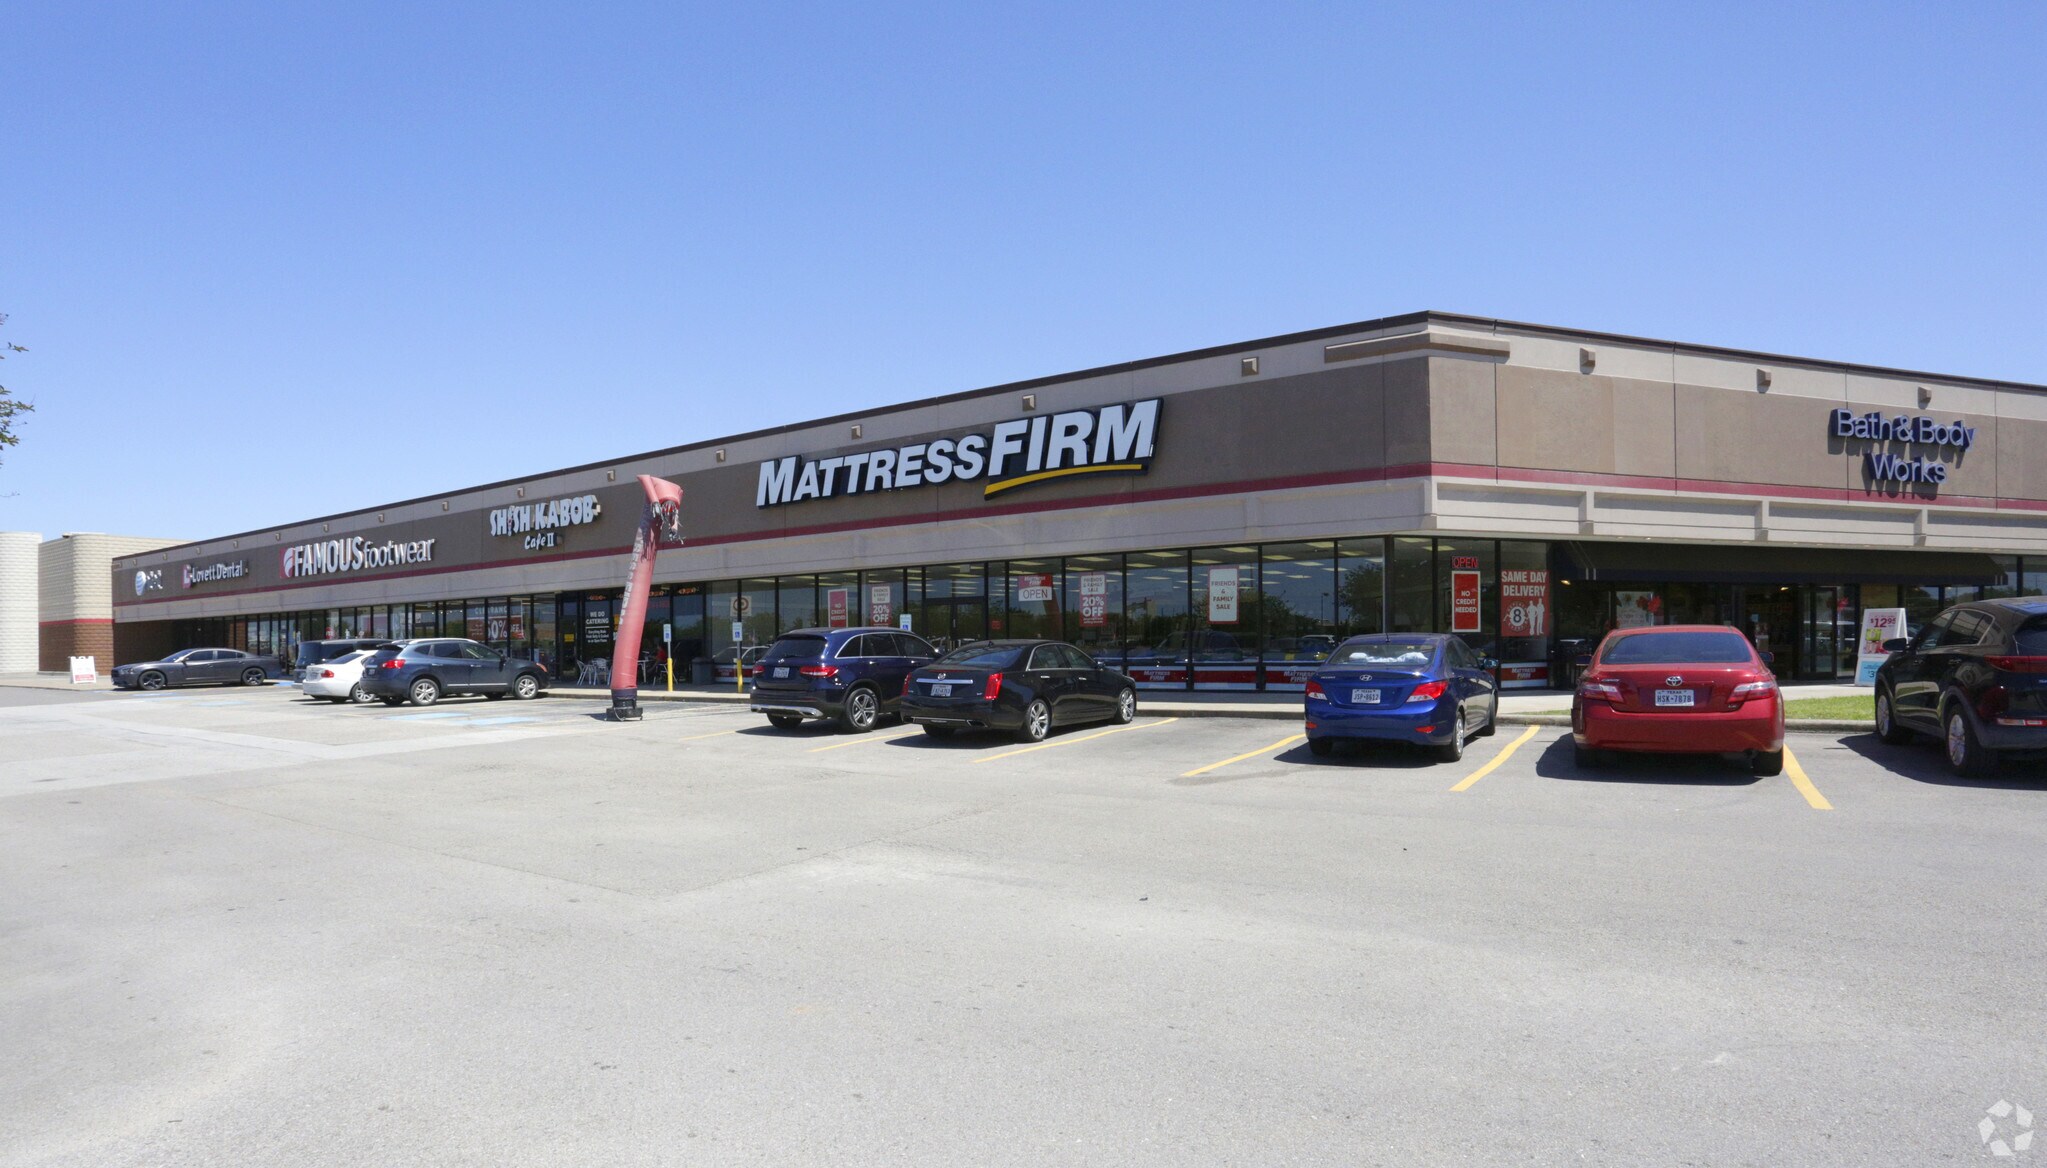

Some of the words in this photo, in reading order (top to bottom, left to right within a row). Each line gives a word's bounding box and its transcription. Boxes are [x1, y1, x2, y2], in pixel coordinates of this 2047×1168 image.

[1831, 408, 1892, 441] Bath
[1893, 414, 1915, 443] &
[1915, 415, 1976, 453] Body
[756, 434, 986, 507] MATTRESS
[985, 398, 1160, 478] FIRM
[1869, 451, 1948, 484] Works
[535, 495, 600, 530] KABOB
[524, 533, 547, 550] Cafe
[294, 537, 364, 577] FAMOUS
[363, 538, 435, 569] footwear
[1453, 557, 1478, 568] OPEN
[191, 565, 217, 583] Lovett
[216, 560, 243, 579] Dental
[1501, 571, 1527, 583] SAME
[1530, 571, 1547, 582] DAY
[1022, 588, 1049, 600] OPEN
[1503, 585, 1546, 597] DELIVERY
[873, 604, 890, 614] 20%
[1083, 597, 1105, 607] 20%
[873, 614, 890, 623] OFF
[1082, 607, 1104, 617] OFF
[1512, 608, 1522, 624] 8
